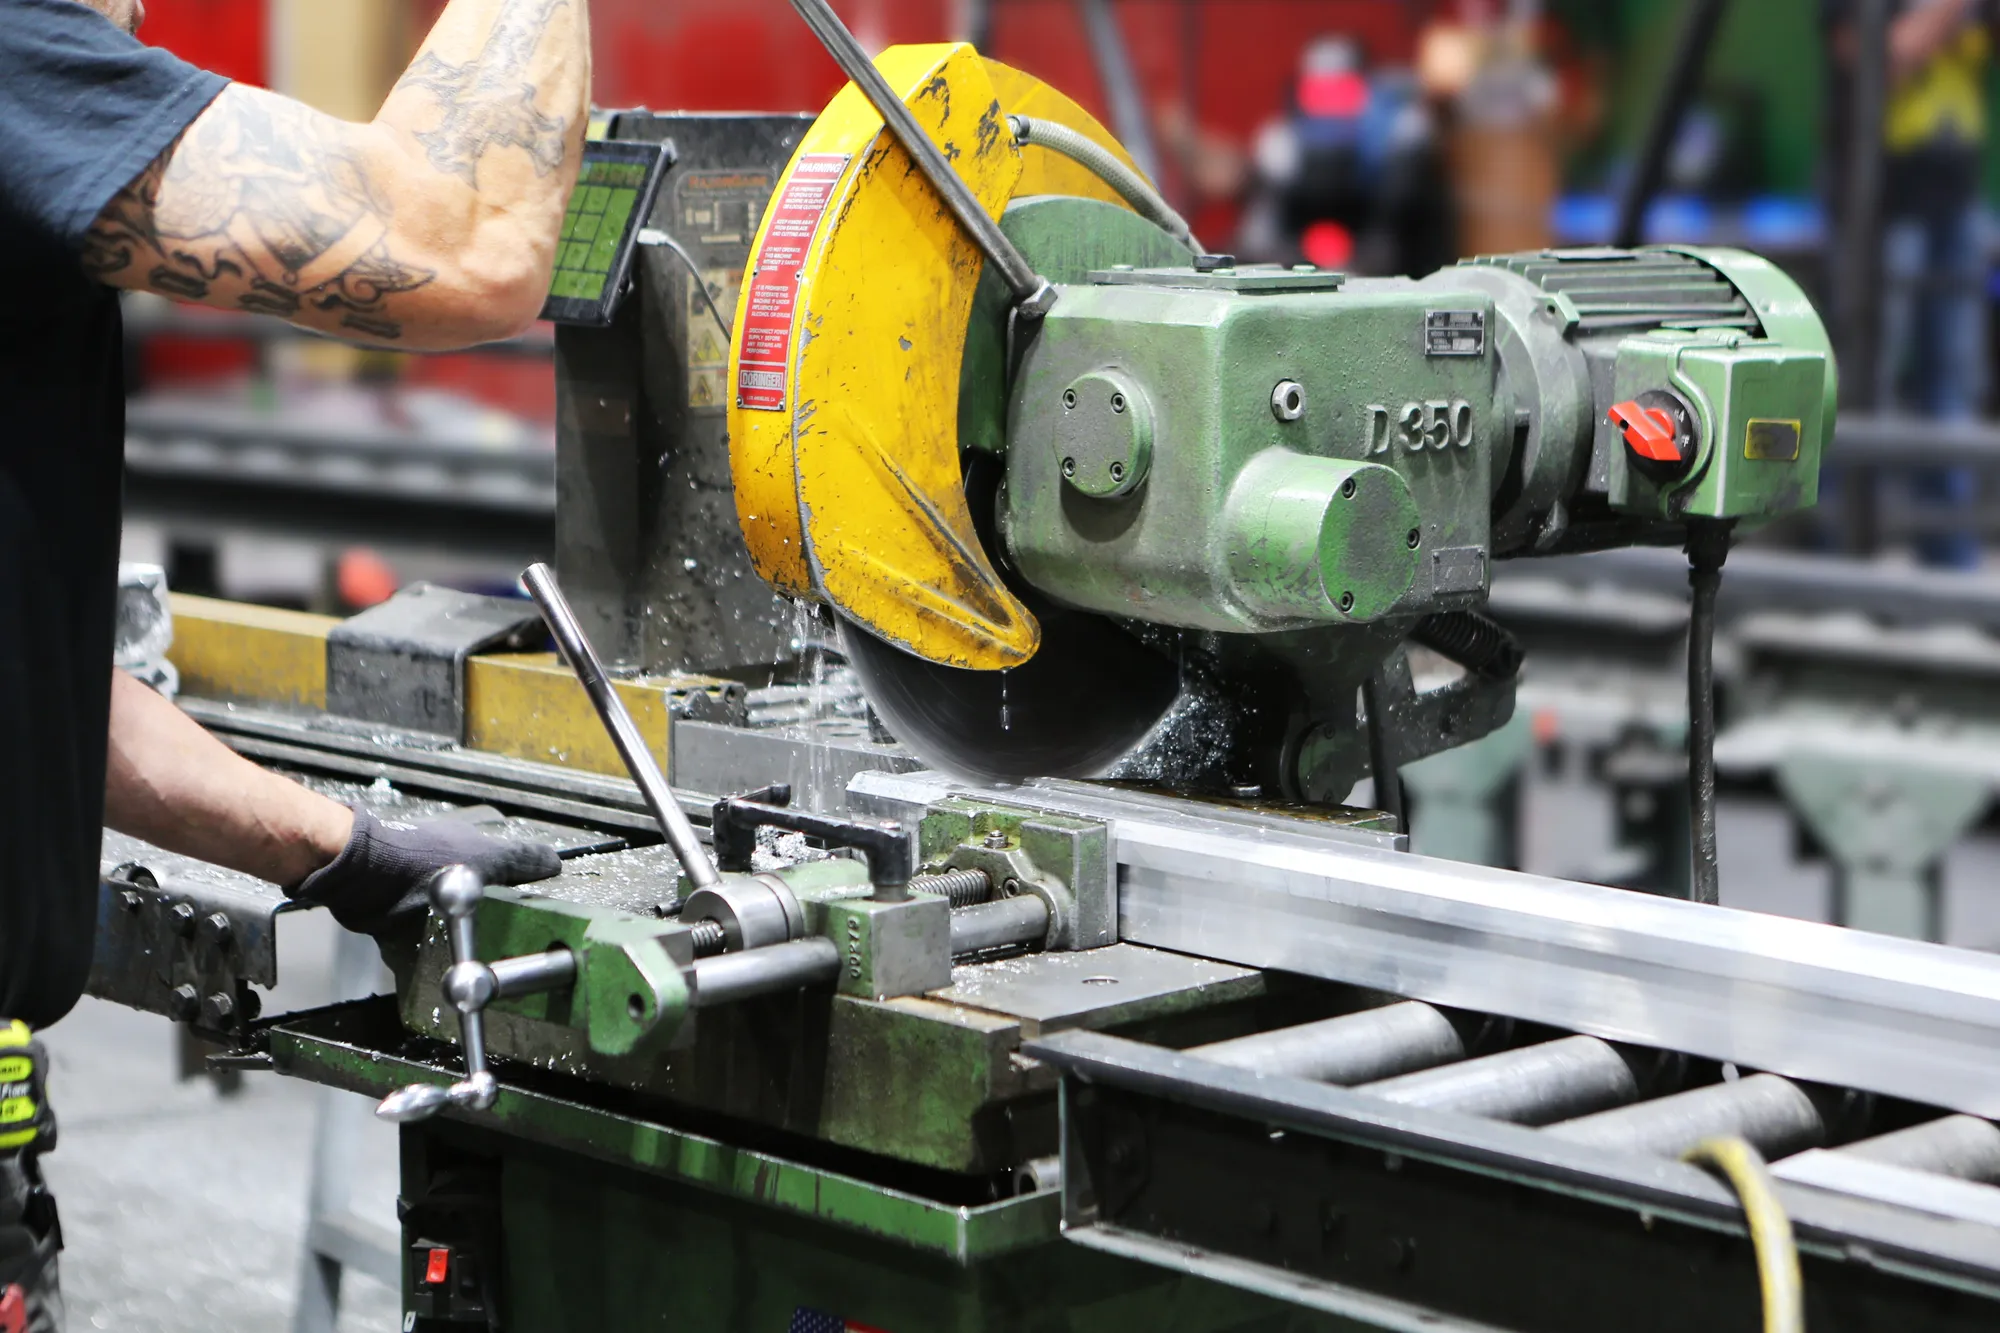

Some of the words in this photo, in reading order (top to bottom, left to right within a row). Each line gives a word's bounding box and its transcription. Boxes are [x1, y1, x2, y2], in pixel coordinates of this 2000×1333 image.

[798, 162, 842, 173] WARNING
[742, 372, 781, 387] DORINGER
[1364, 404, 1391, 459] D
[1398, 400, 1474, 451] 350
